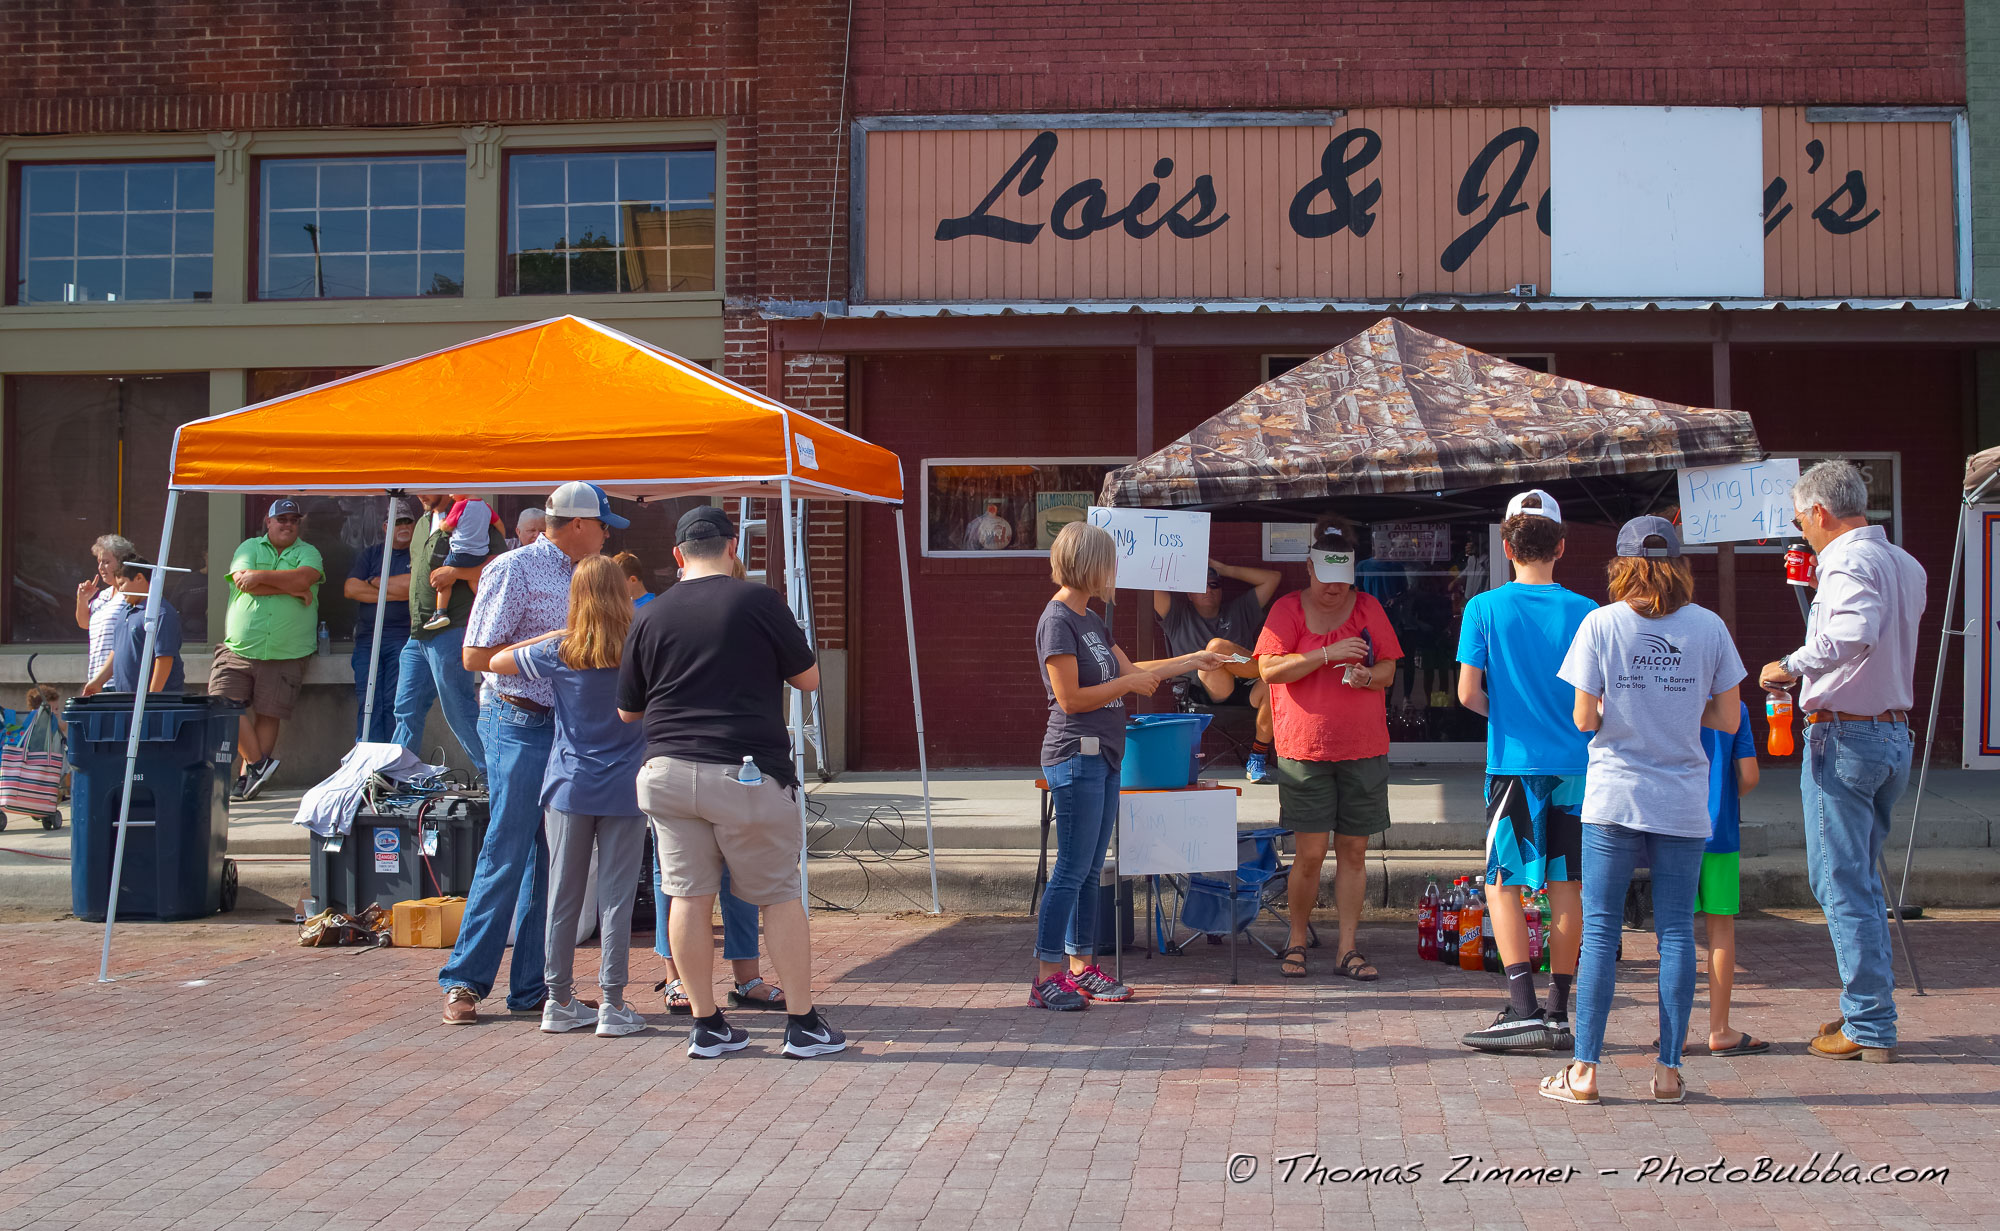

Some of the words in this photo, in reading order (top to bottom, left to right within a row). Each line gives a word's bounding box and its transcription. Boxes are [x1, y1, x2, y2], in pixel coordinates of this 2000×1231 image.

[934, 131, 1231, 245] Lois
[1288, 127, 1382, 239] &
[1687, 469, 1743, 510] Ring
[1037, 493, 1094, 513] HAMBURGERS
[1143, 515, 1184, 548] Toss
[1632, 655, 1682, 666] FALCON
[1632, 682, 1647, 690] Stop
[1654, 675, 1668, 683] The
[1669, 676, 1696, 684] Barrett
[1663, 684, 1687, 692] House
